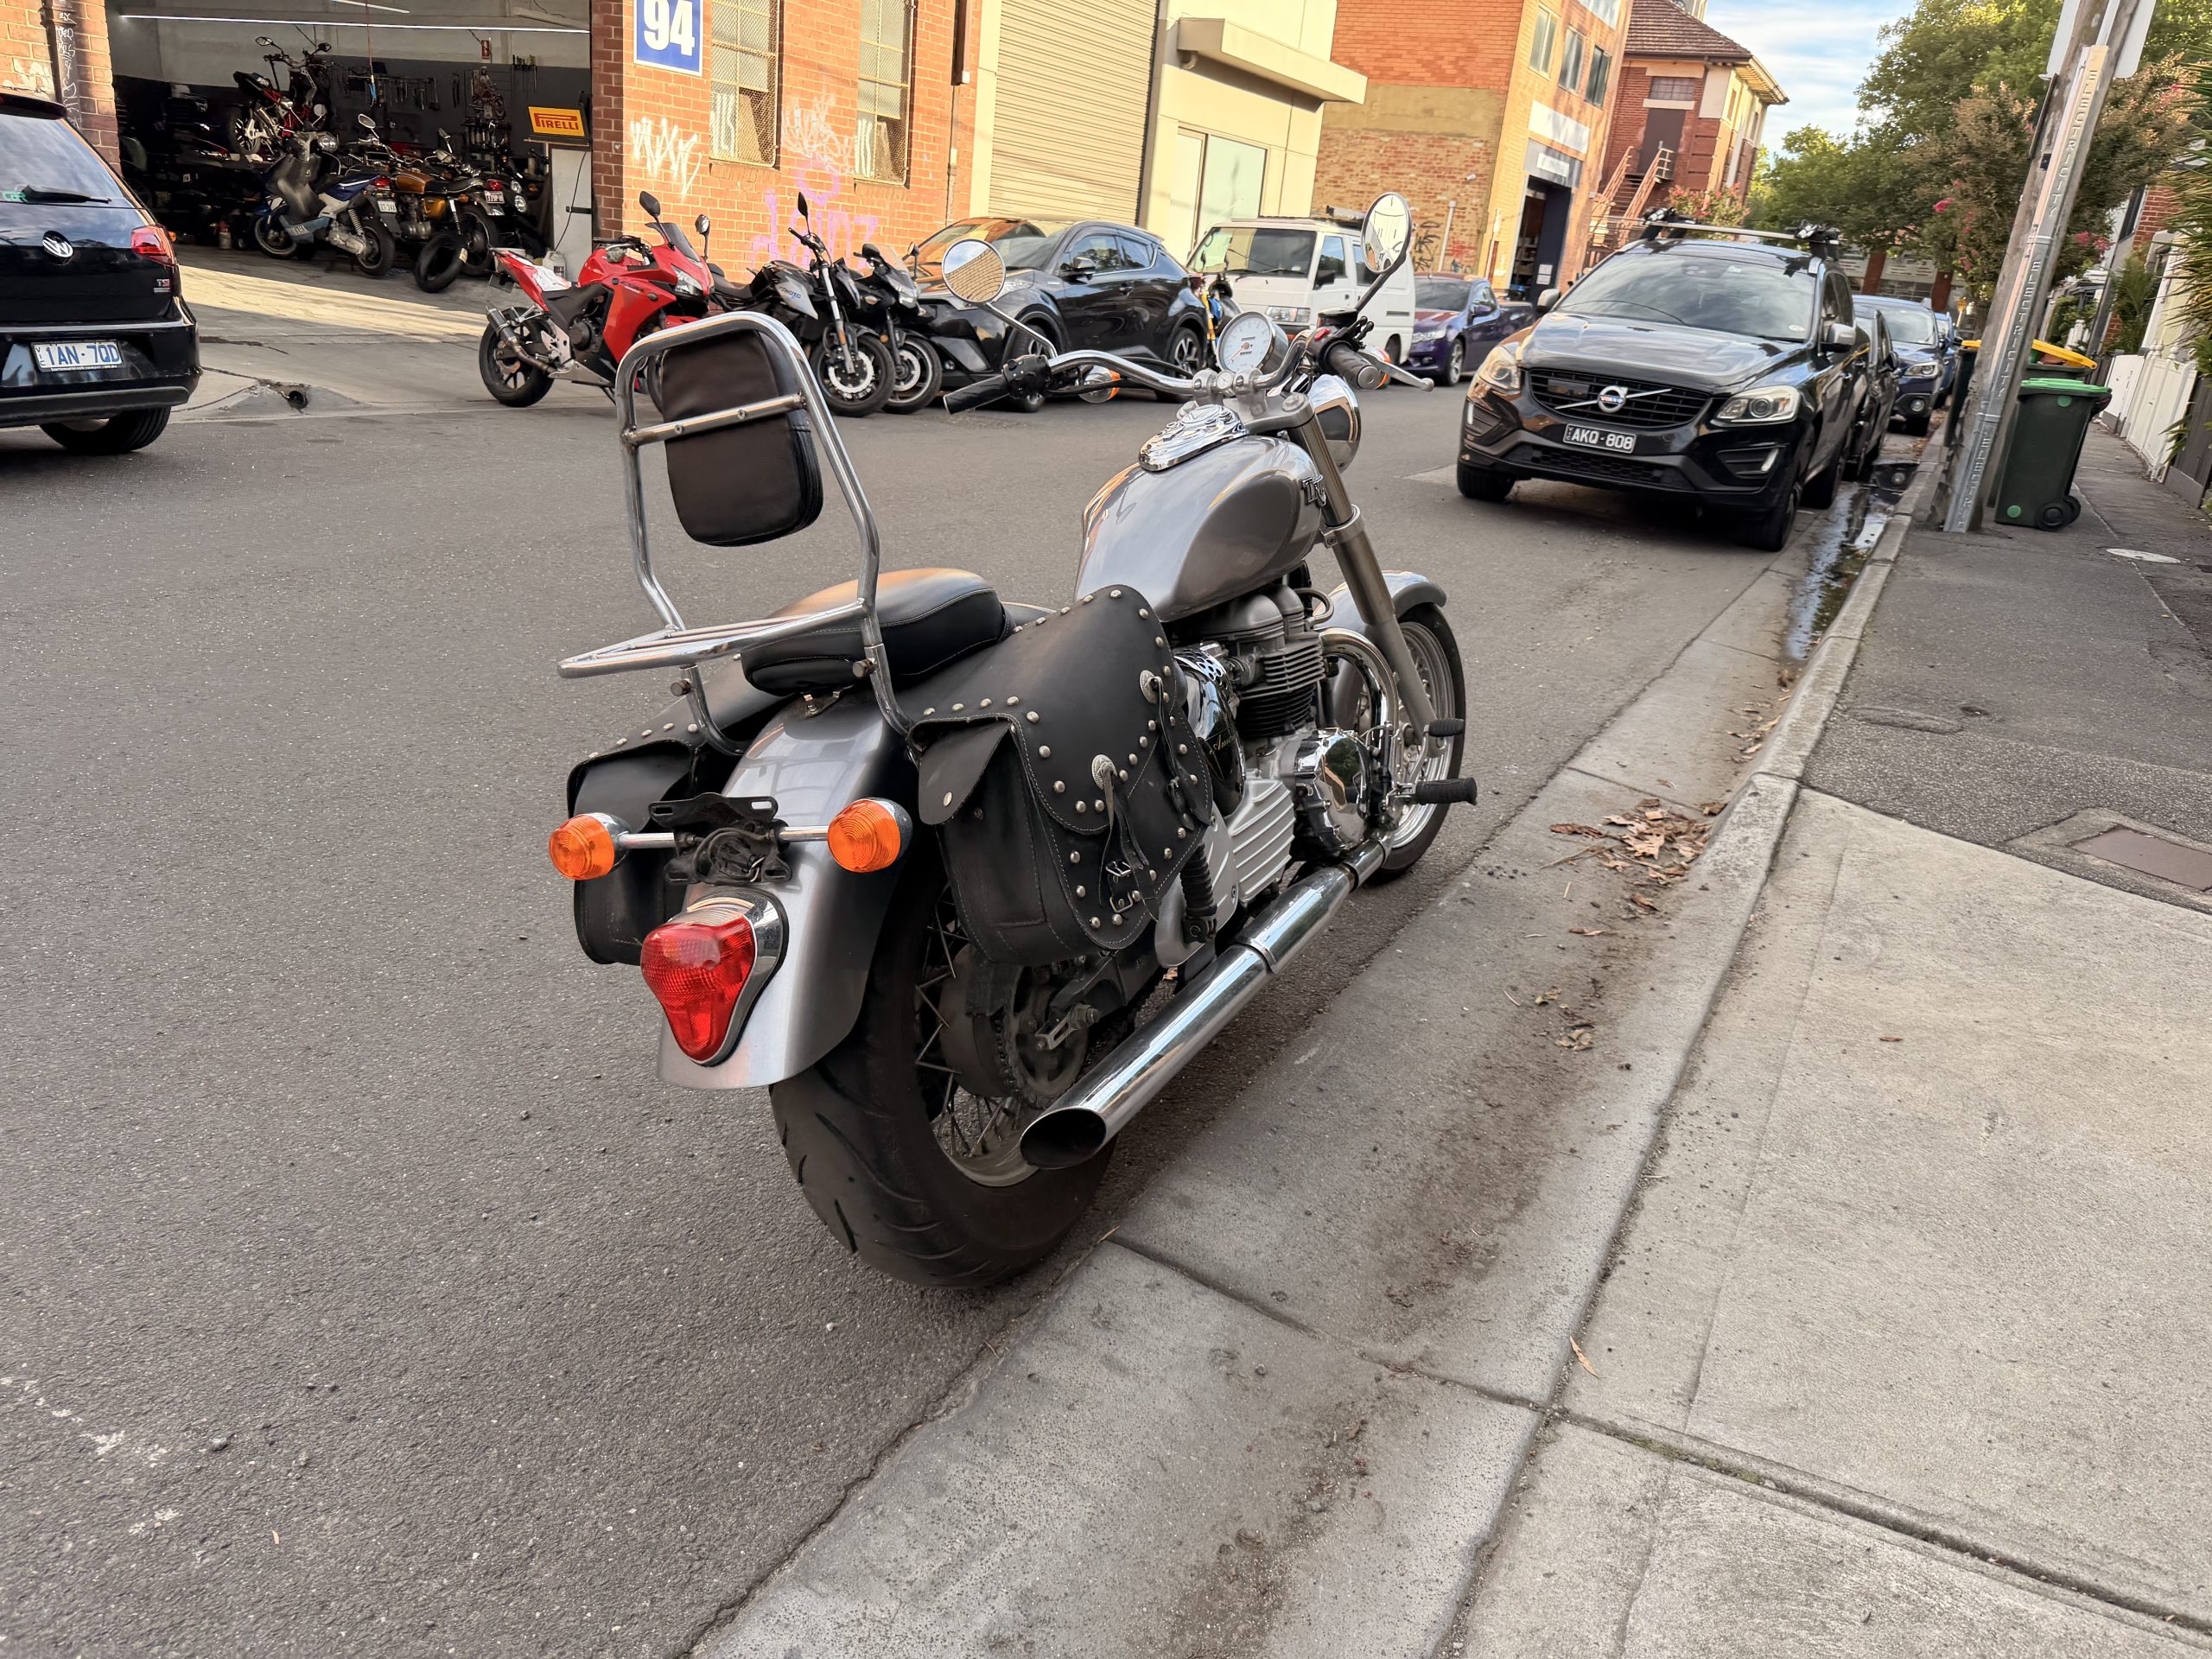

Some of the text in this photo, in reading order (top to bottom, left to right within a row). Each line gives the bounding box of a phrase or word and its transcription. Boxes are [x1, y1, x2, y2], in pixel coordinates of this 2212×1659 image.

[644, 0, 695, 56] 94
[534, 113, 579, 130] PIRELLI
[2049, 70, 2098, 217] ELECTRICITY
